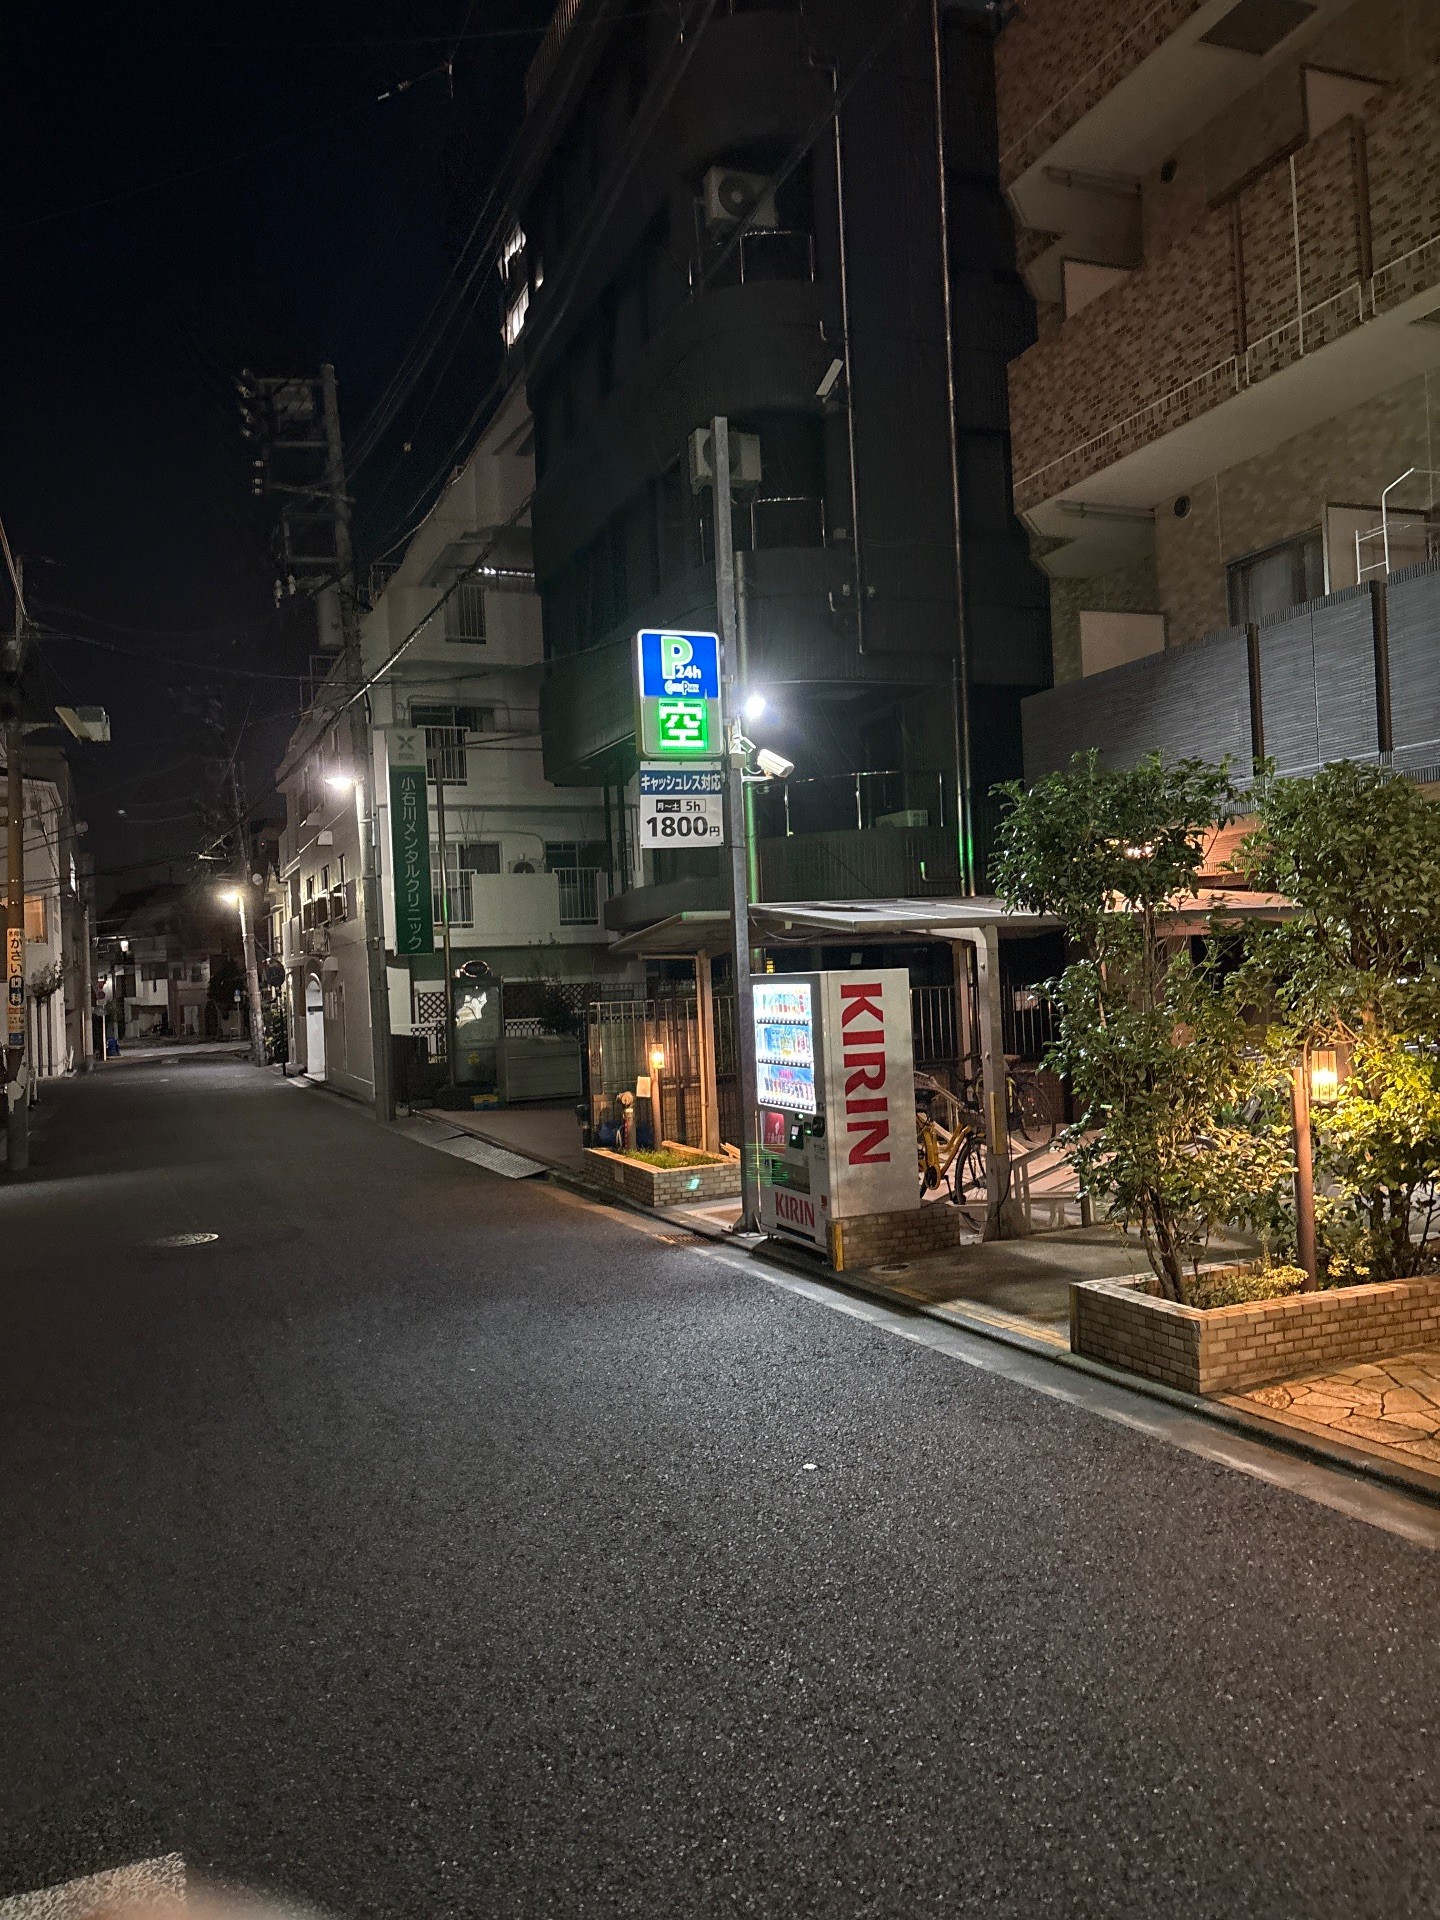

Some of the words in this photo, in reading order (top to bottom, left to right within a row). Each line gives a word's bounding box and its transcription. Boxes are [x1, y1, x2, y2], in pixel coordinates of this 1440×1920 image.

[661, 635, 694, 680] P
[675, 665, 702, 679] 24h
[659, 701, 705, 747] 空
[641, 773, 721, 791] キャッシュレス対応
[686, 801, 701, 812] 5h
[646, 816, 720, 838] 1800円
[401, 776, 422, 950] 小石川メンタルクリニック
[840, 982, 891, 1166] KIRIN
[774, 1191, 815, 1229] KIRIN
